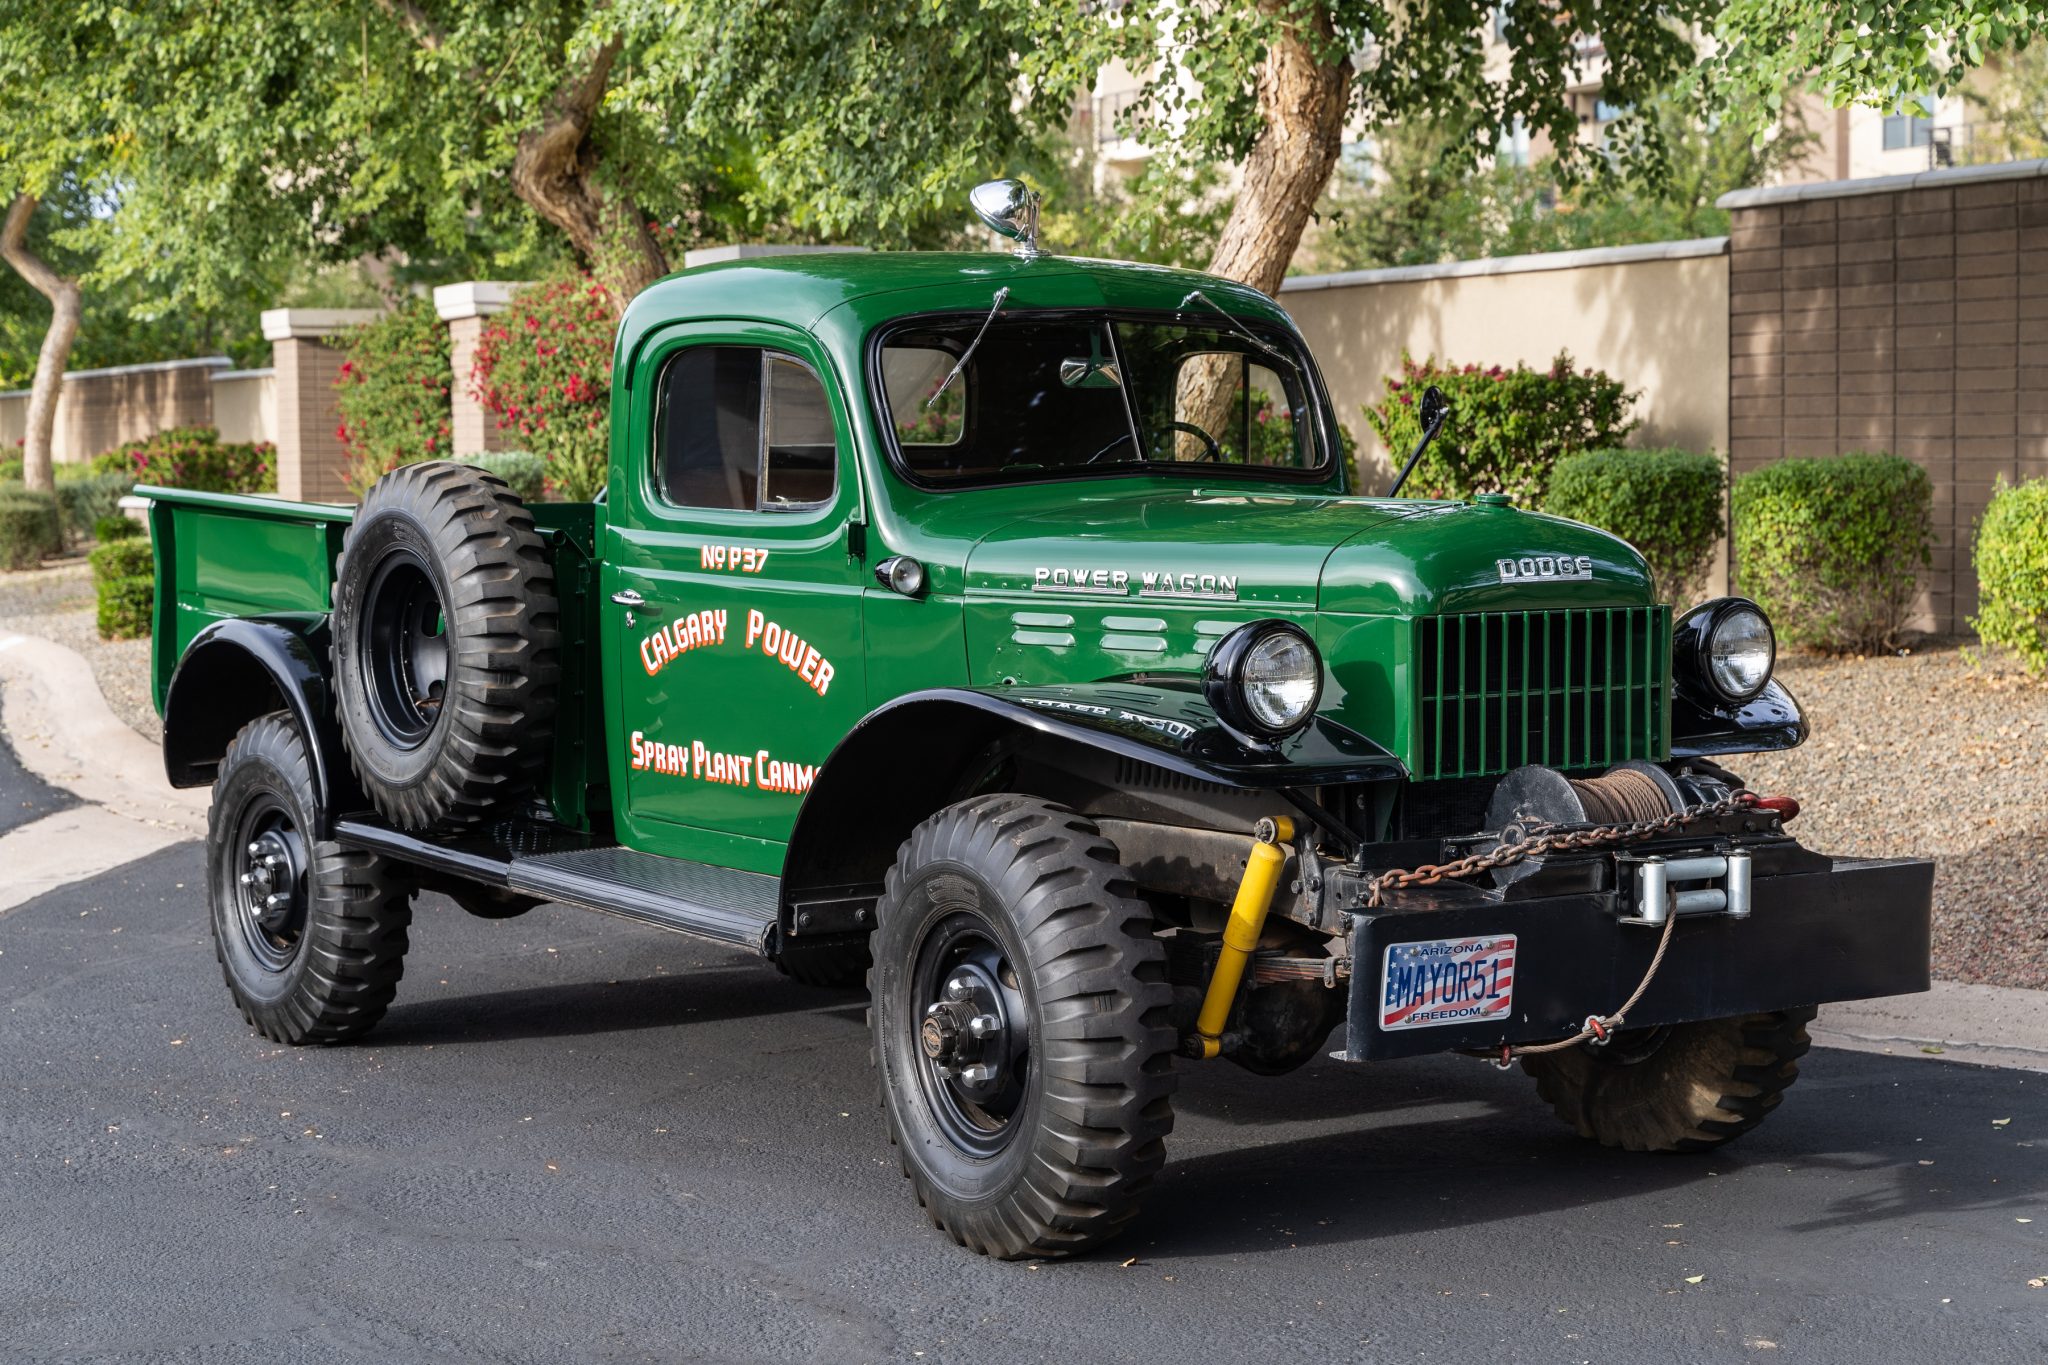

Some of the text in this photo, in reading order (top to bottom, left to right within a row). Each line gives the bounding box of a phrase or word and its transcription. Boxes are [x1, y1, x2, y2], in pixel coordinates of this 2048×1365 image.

[728, 547, 769, 573] P37
[1495, 556, 1592, 578] DODGE
[1034, 567, 1239, 595] POWER WAGON
[640, 608, 835, 696] CALGARY POWER
[631, 731, 822, 795] SPRAY PLANT CANM
[1420, 943, 1484, 957] ARIZONA
[1396, 958, 1500, 1008] MAYOR51
[1412, 1007, 1481, 1022] FREEDOM
